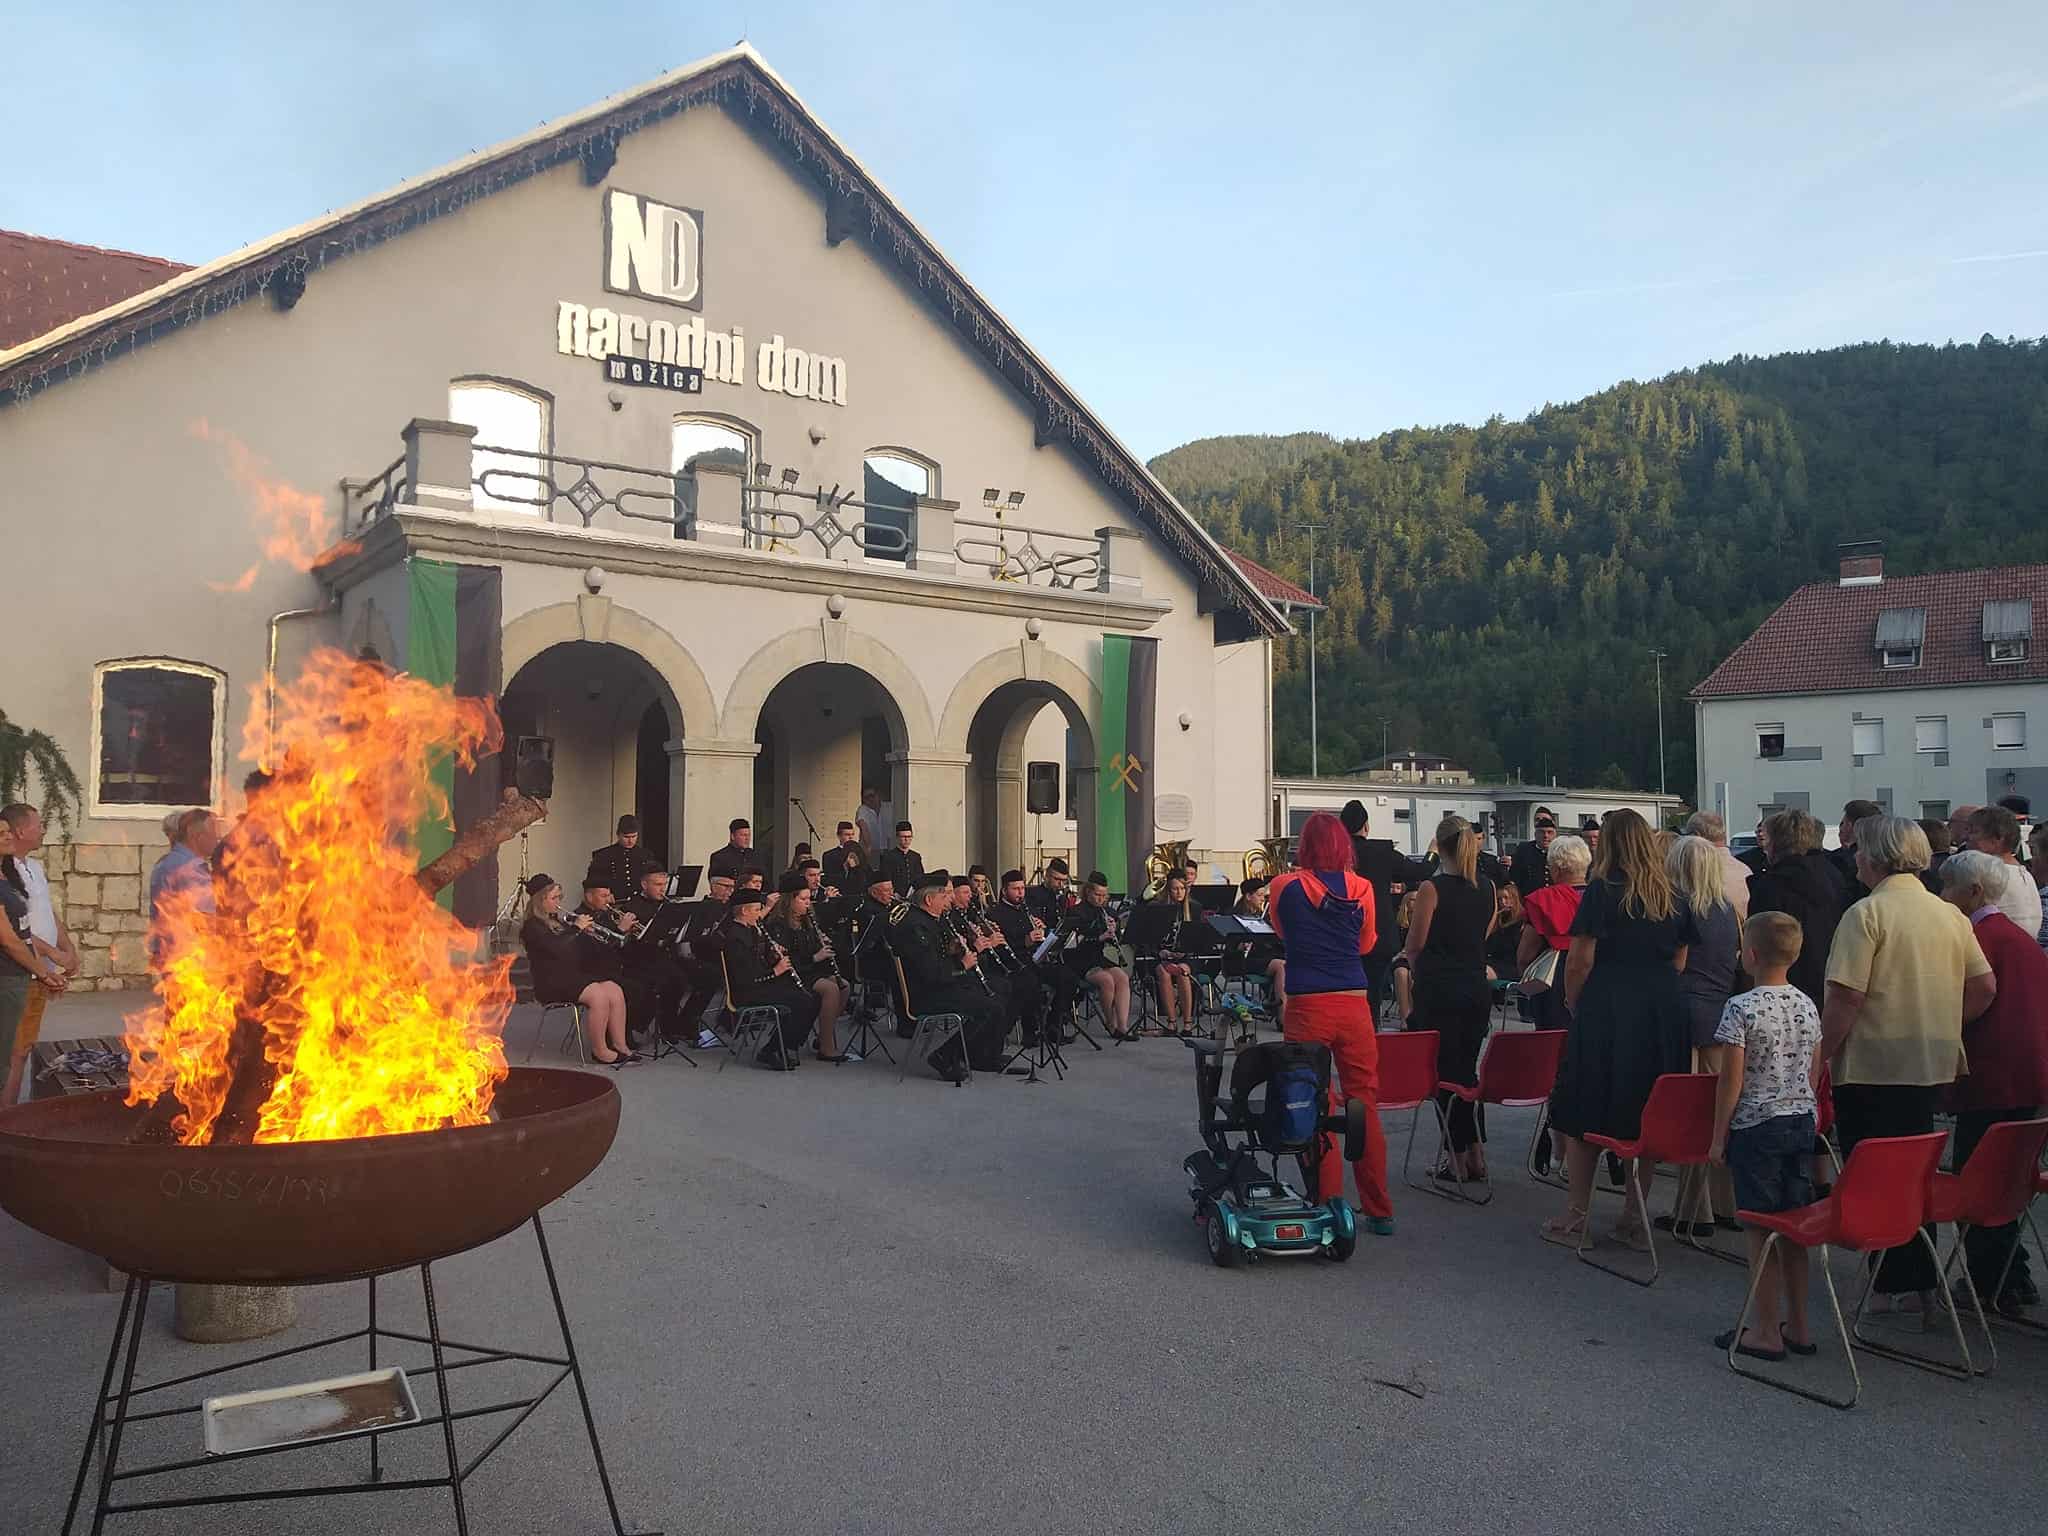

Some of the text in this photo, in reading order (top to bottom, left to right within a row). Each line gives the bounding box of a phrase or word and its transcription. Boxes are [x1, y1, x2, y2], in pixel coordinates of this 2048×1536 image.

[609, 190, 700, 302] ND
[557, 300, 848, 407] narodni dom
[610, 360, 699, 391] mežica
